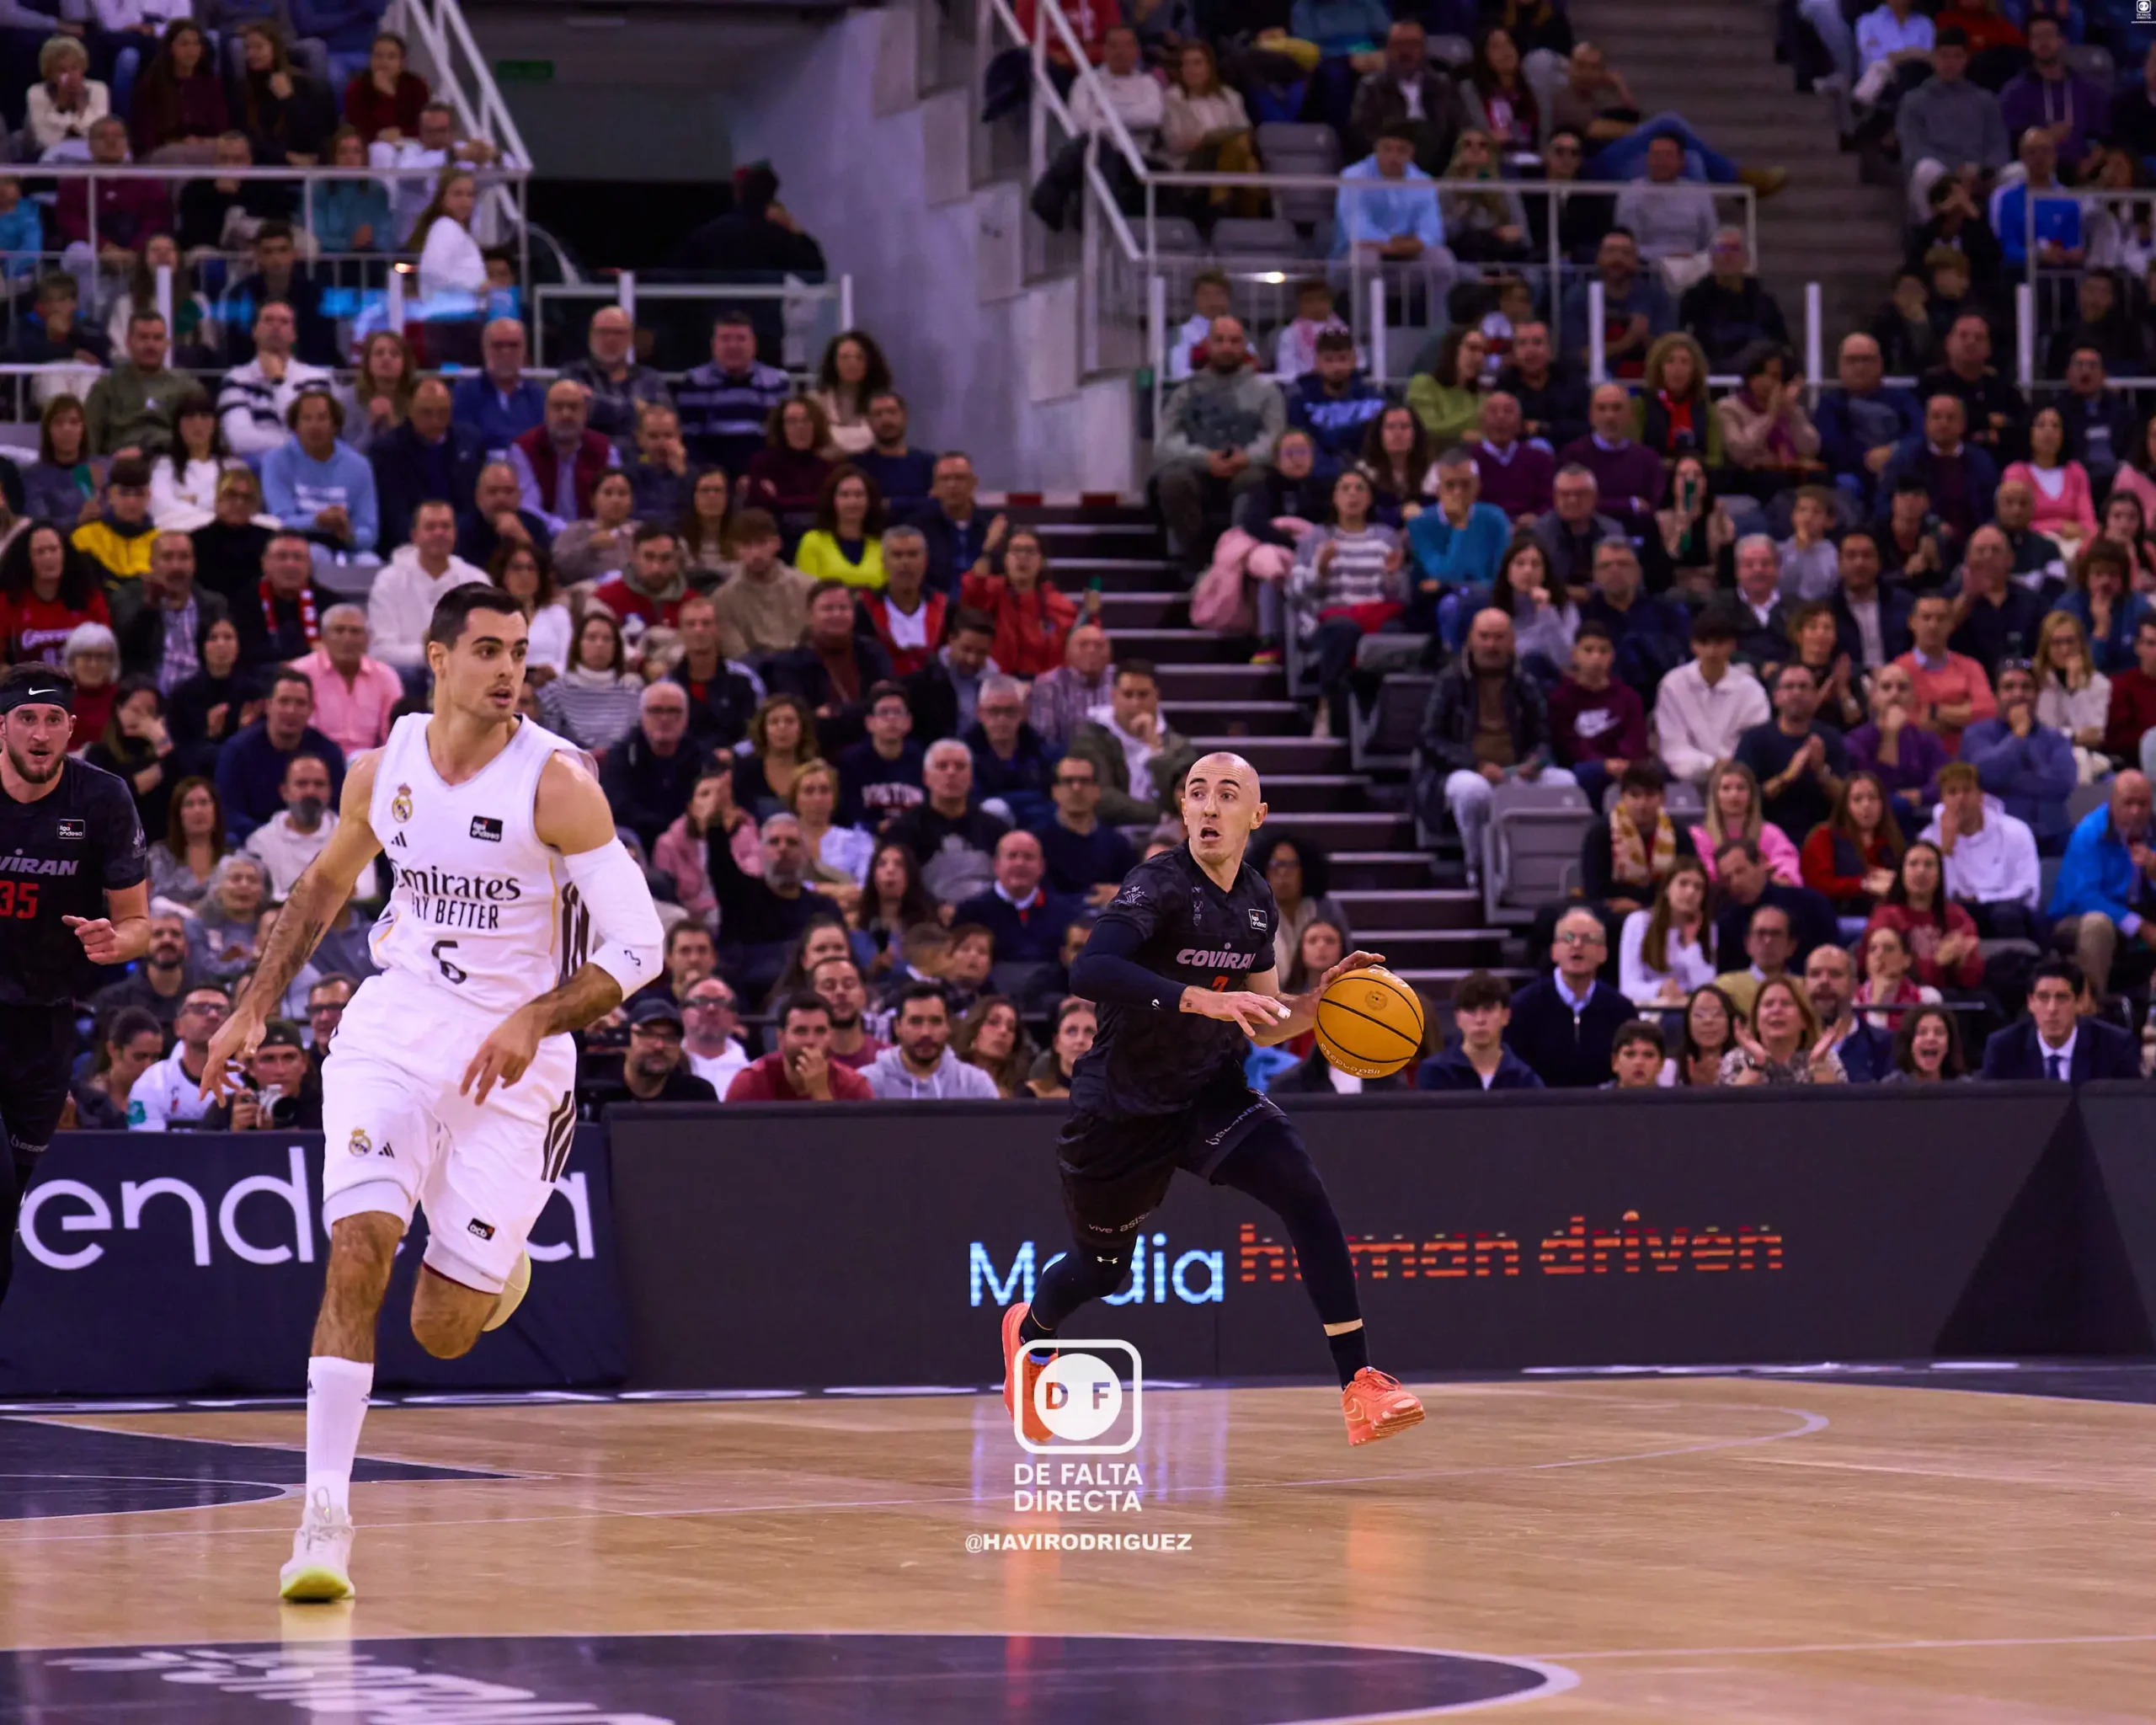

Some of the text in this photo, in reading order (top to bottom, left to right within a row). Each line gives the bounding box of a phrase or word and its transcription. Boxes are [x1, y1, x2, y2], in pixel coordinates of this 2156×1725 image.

[0, 880, 40, 919] 35
[435, 899, 499, 930] BETTER
[431, 940, 467, 985] 6
[1177, 942, 1257, 969] COVIRA
[19, 1146, 595, 1269] enda
[1088, 1211, 1150, 1234] vive asis
[1240, 1224, 1519, 1282] hman
[1540, 1210, 1782, 1274] driven
